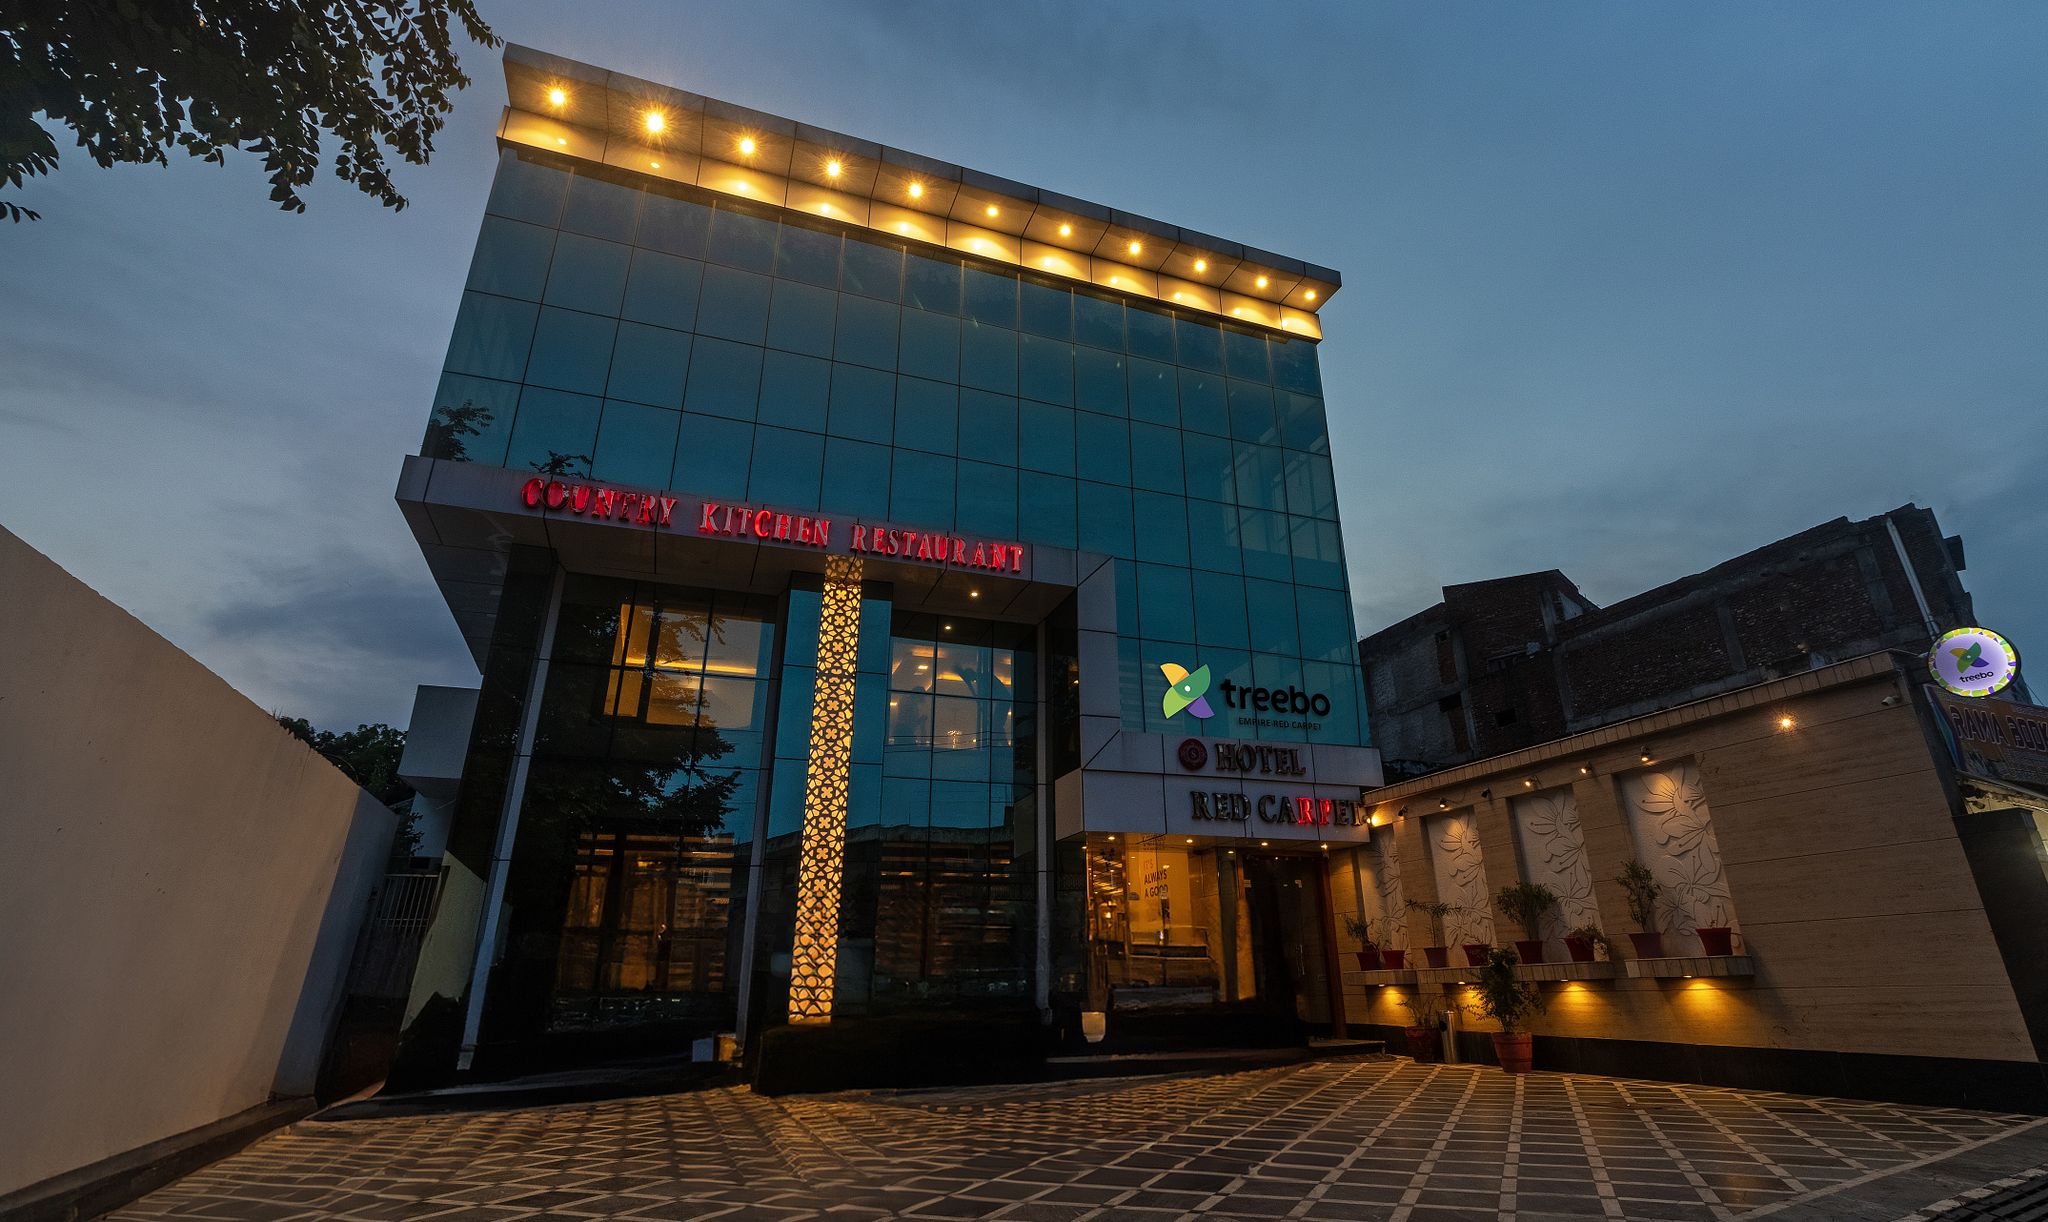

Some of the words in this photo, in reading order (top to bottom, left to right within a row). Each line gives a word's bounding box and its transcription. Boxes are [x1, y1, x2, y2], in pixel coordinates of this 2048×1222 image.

[521, 477, 678, 528] COUNTRY
[699, 500, 832, 547] KITCHEN
[851, 522, 1025, 574] RESTAURANT
[1959, 671, 1994, 683] treebo
[1220, 679, 1331, 716] treebo
[1238, 717, 1271, 727] EMPIRE
[1272, 720, 1290, 728] RED
[1292, 721, 1321, 731] CARPET
[1950, 704, 2010, 746] RAMA
[1215, 743, 1307, 776] HOTEL
[1190, 790, 1252, 822] RED
[1258, 795, 1362, 827] CARPET
[1144, 869, 1167, 885] ALWAYS
